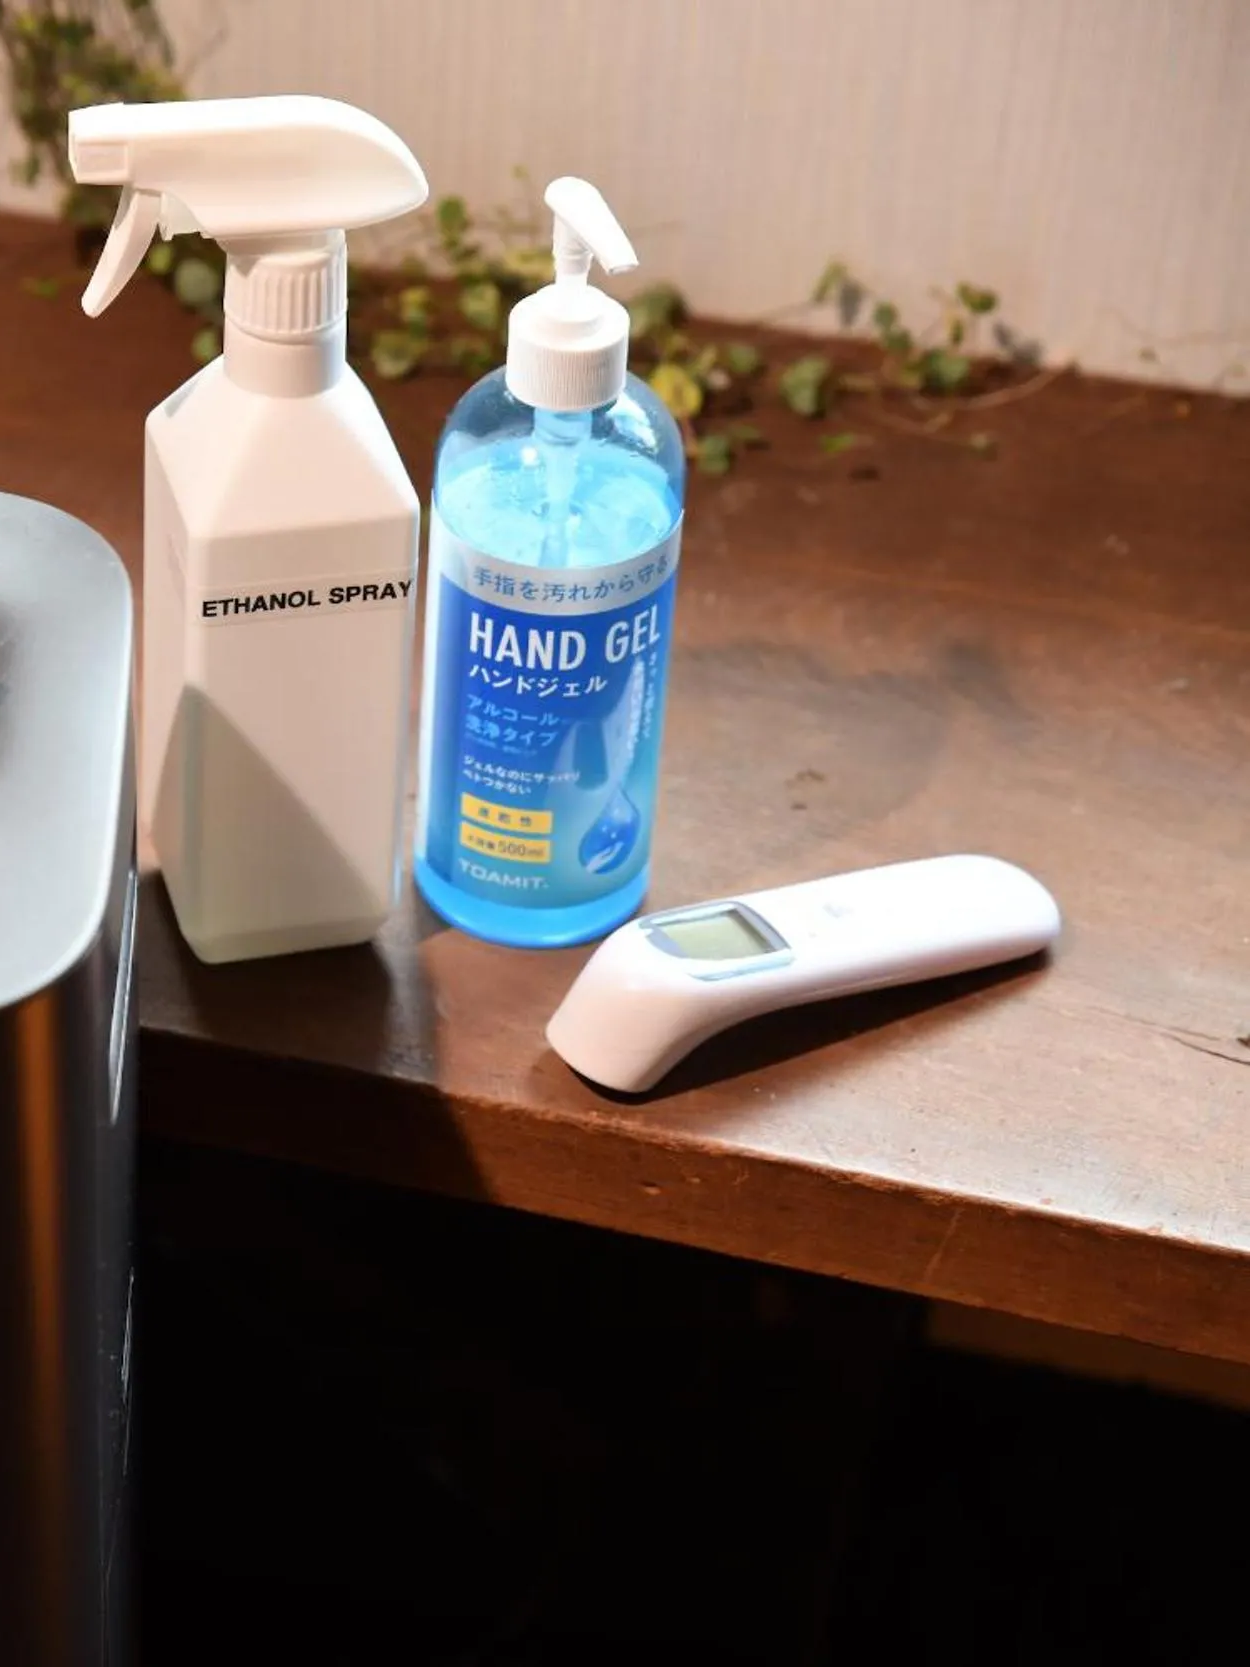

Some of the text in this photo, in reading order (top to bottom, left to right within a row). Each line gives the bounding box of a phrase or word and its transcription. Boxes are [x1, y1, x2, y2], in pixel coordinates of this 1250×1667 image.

[472, 554, 671, 603] 手指を汚れから守る
[202, 580, 412, 618] ETHANOL SPRAY
[469, 603, 661, 672] HAND GEL
[468, 664, 609, 698] ハンドジェル
[466, 694, 560, 727] アルコール
